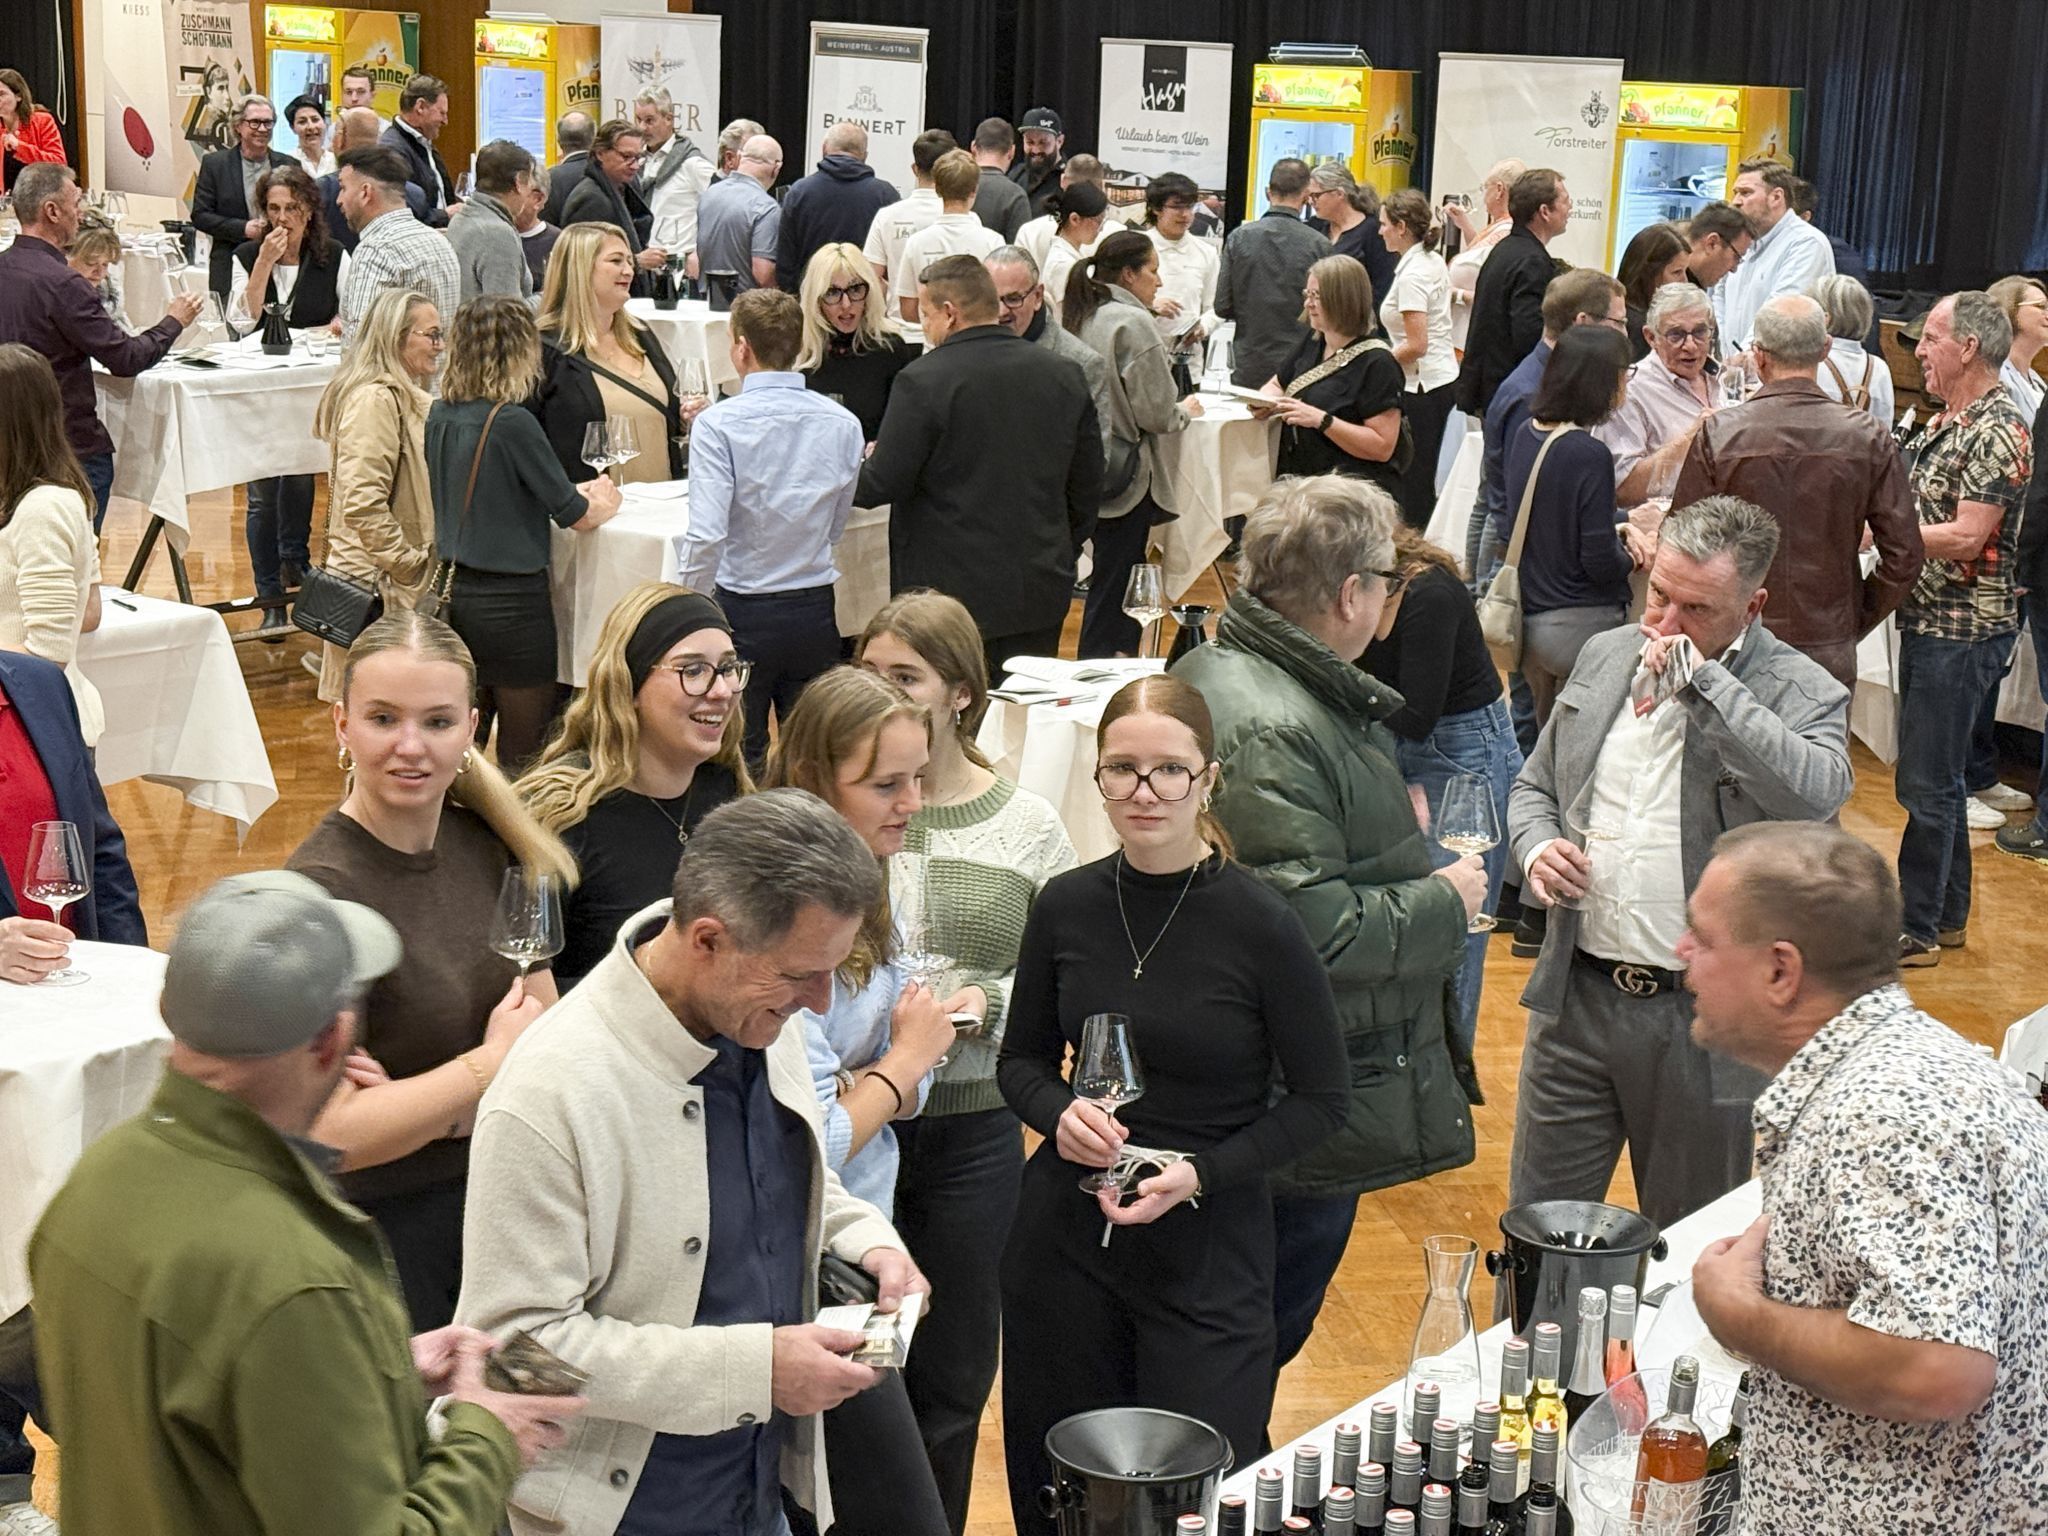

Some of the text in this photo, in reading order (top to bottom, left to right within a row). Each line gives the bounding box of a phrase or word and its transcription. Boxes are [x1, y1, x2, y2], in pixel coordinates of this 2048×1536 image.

[180, 13, 231, 30] ZUSCHMANN
[826, 41, 872, 51] WEINVIERTEL
[880, 45, 911, 54] AUSTRIA
[1654, 101, 1703, 118] pfanner
[1115, 127, 1210, 147] Urlaub beim Wein
[1534, 127, 1608, 149] Forstreiter
[1373, 134, 1415, 160] pfanner
